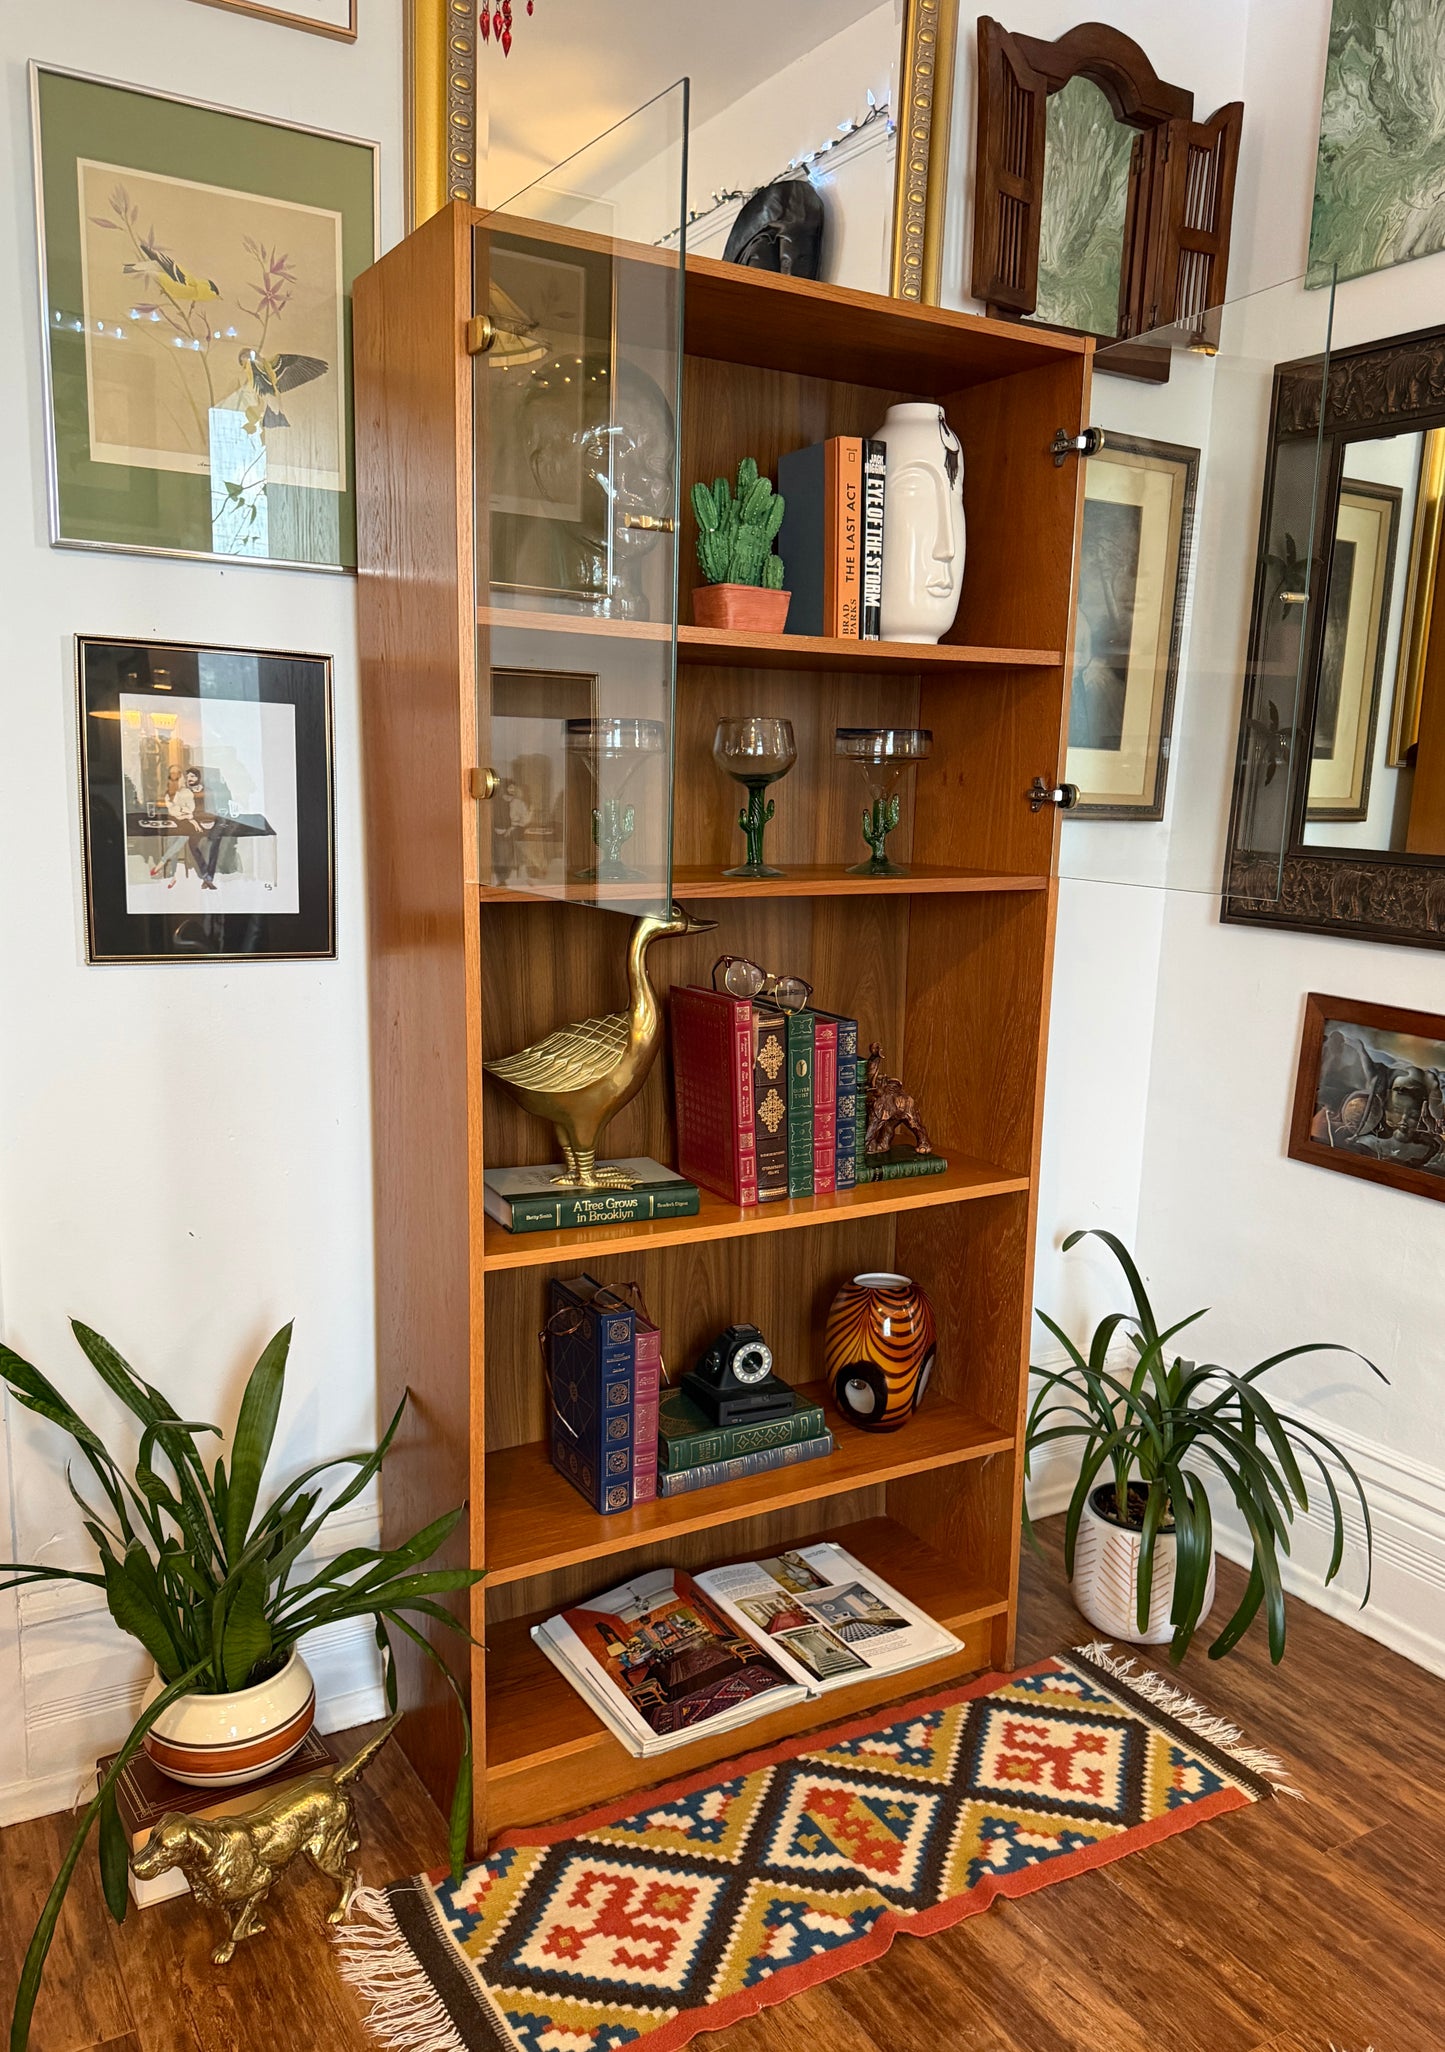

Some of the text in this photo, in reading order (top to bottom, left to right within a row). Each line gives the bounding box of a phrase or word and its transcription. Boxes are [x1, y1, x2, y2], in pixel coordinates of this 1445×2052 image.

[869, 454, 884, 465] JACK
[845, 483, 856, 582] THE LAST ACT
[865, 479, 884, 607] EYE OF THE STORM
[842, 604, 850, 635] BRAD
[849, 599, 857, 635] PARKS
[573, 1198, 638, 1212] A Tree Grows
[576, 1208, 634, 1223] in Brooklyn
